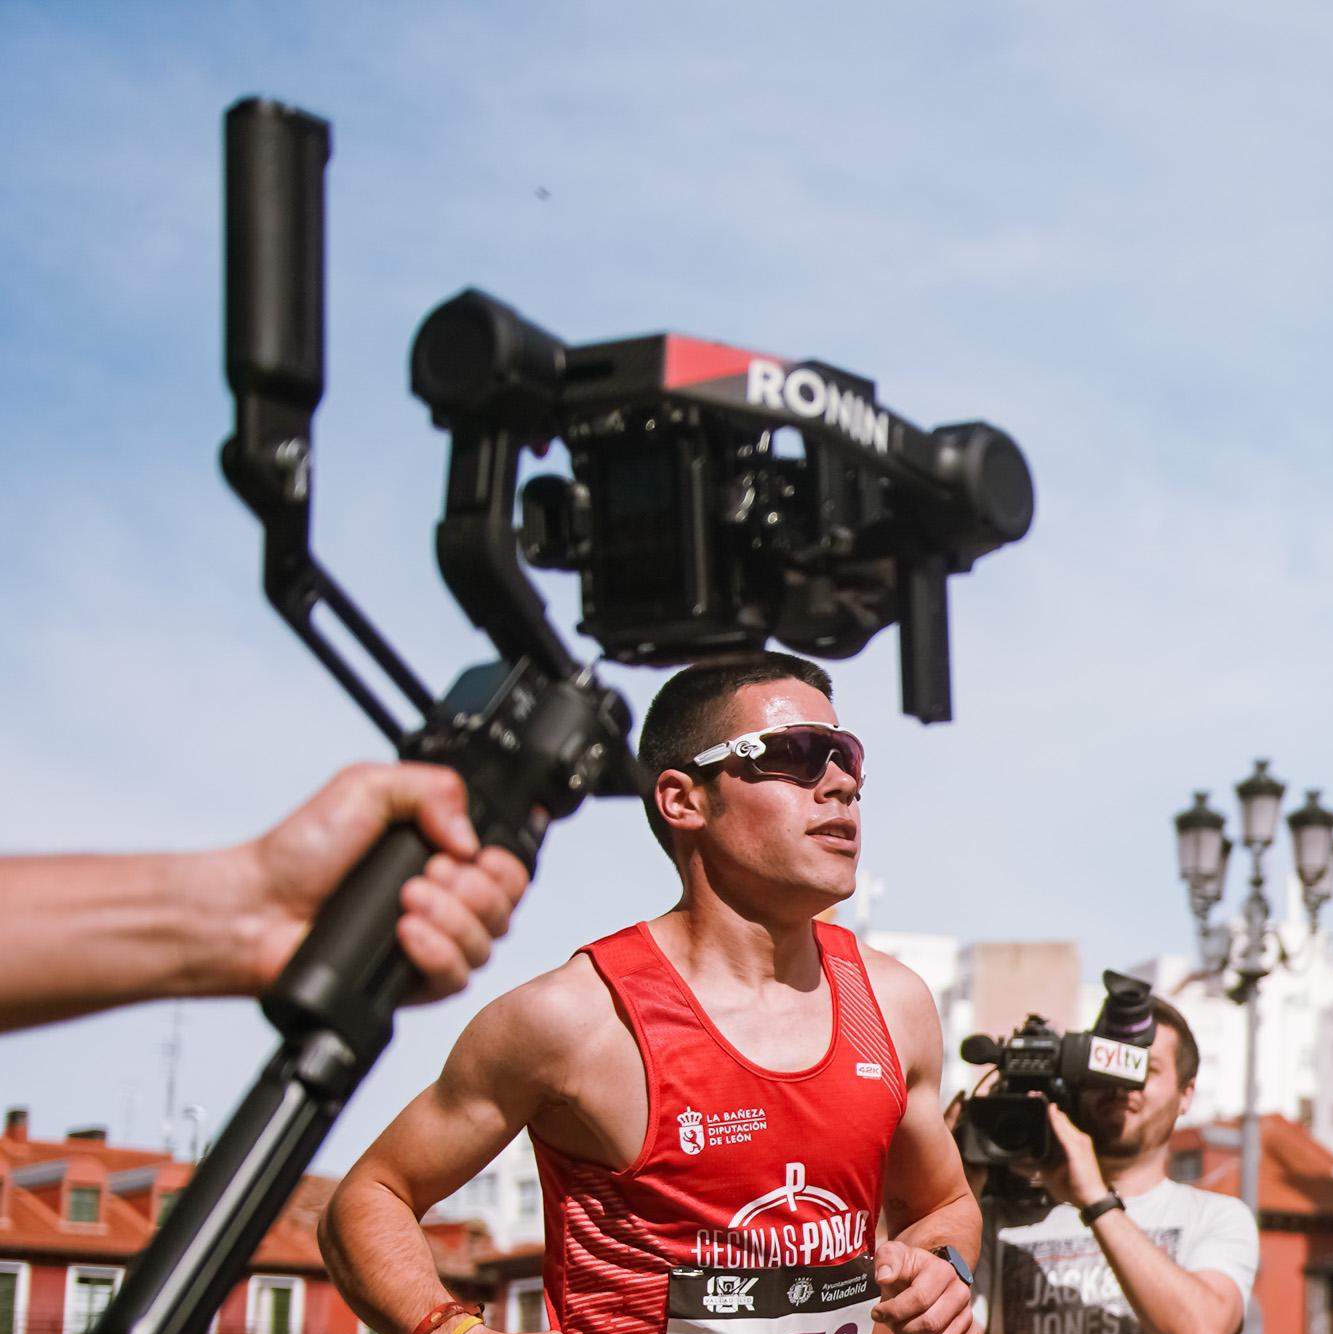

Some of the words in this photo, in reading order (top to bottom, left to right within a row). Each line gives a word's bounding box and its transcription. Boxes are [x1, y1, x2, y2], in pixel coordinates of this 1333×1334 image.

[746, 358, 889, 455] RONIN
[1094, 1044, 1142, 1070] cyltv
[706, 1113, 720, 1124] LA
[724, 1107, 766, 1122] BAÑEZA
[708, 1120, 768, 1137] DIPUTACIÓN
[709, 1136, 723, 1147] DE
[726, 1133, 752, 1145] LEÓN
[693, 1225, 798, 1269] CECINAS
[821, 1281, 867, 1303] Valladolid
